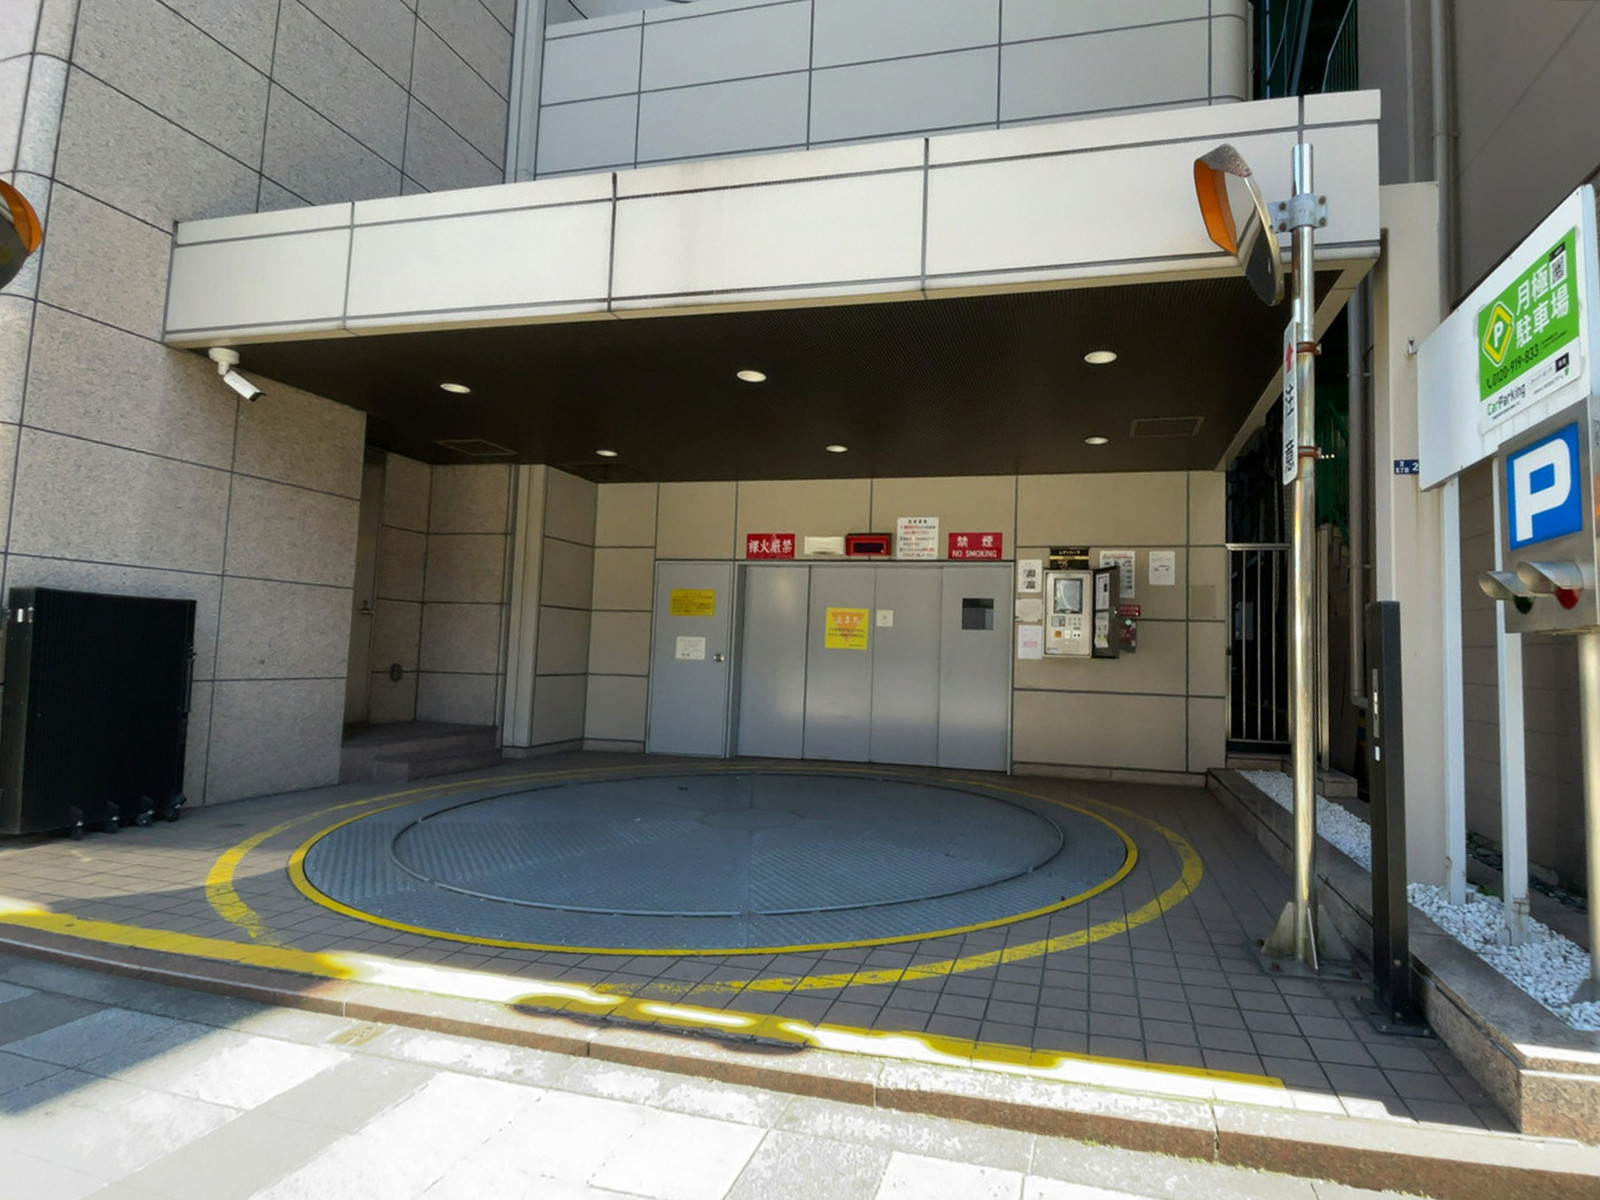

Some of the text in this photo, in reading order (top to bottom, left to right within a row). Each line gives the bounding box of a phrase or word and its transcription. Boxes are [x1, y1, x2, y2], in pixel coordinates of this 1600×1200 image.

[1516, 263, 1549, 315] 月極
[1514, 283, 1569, 349] 駐車場
[1487, 383, 1525, 415] CarParking
[1513, 438, 1571, 542] P
[951, 549, 998, 558] NO SMOKING
